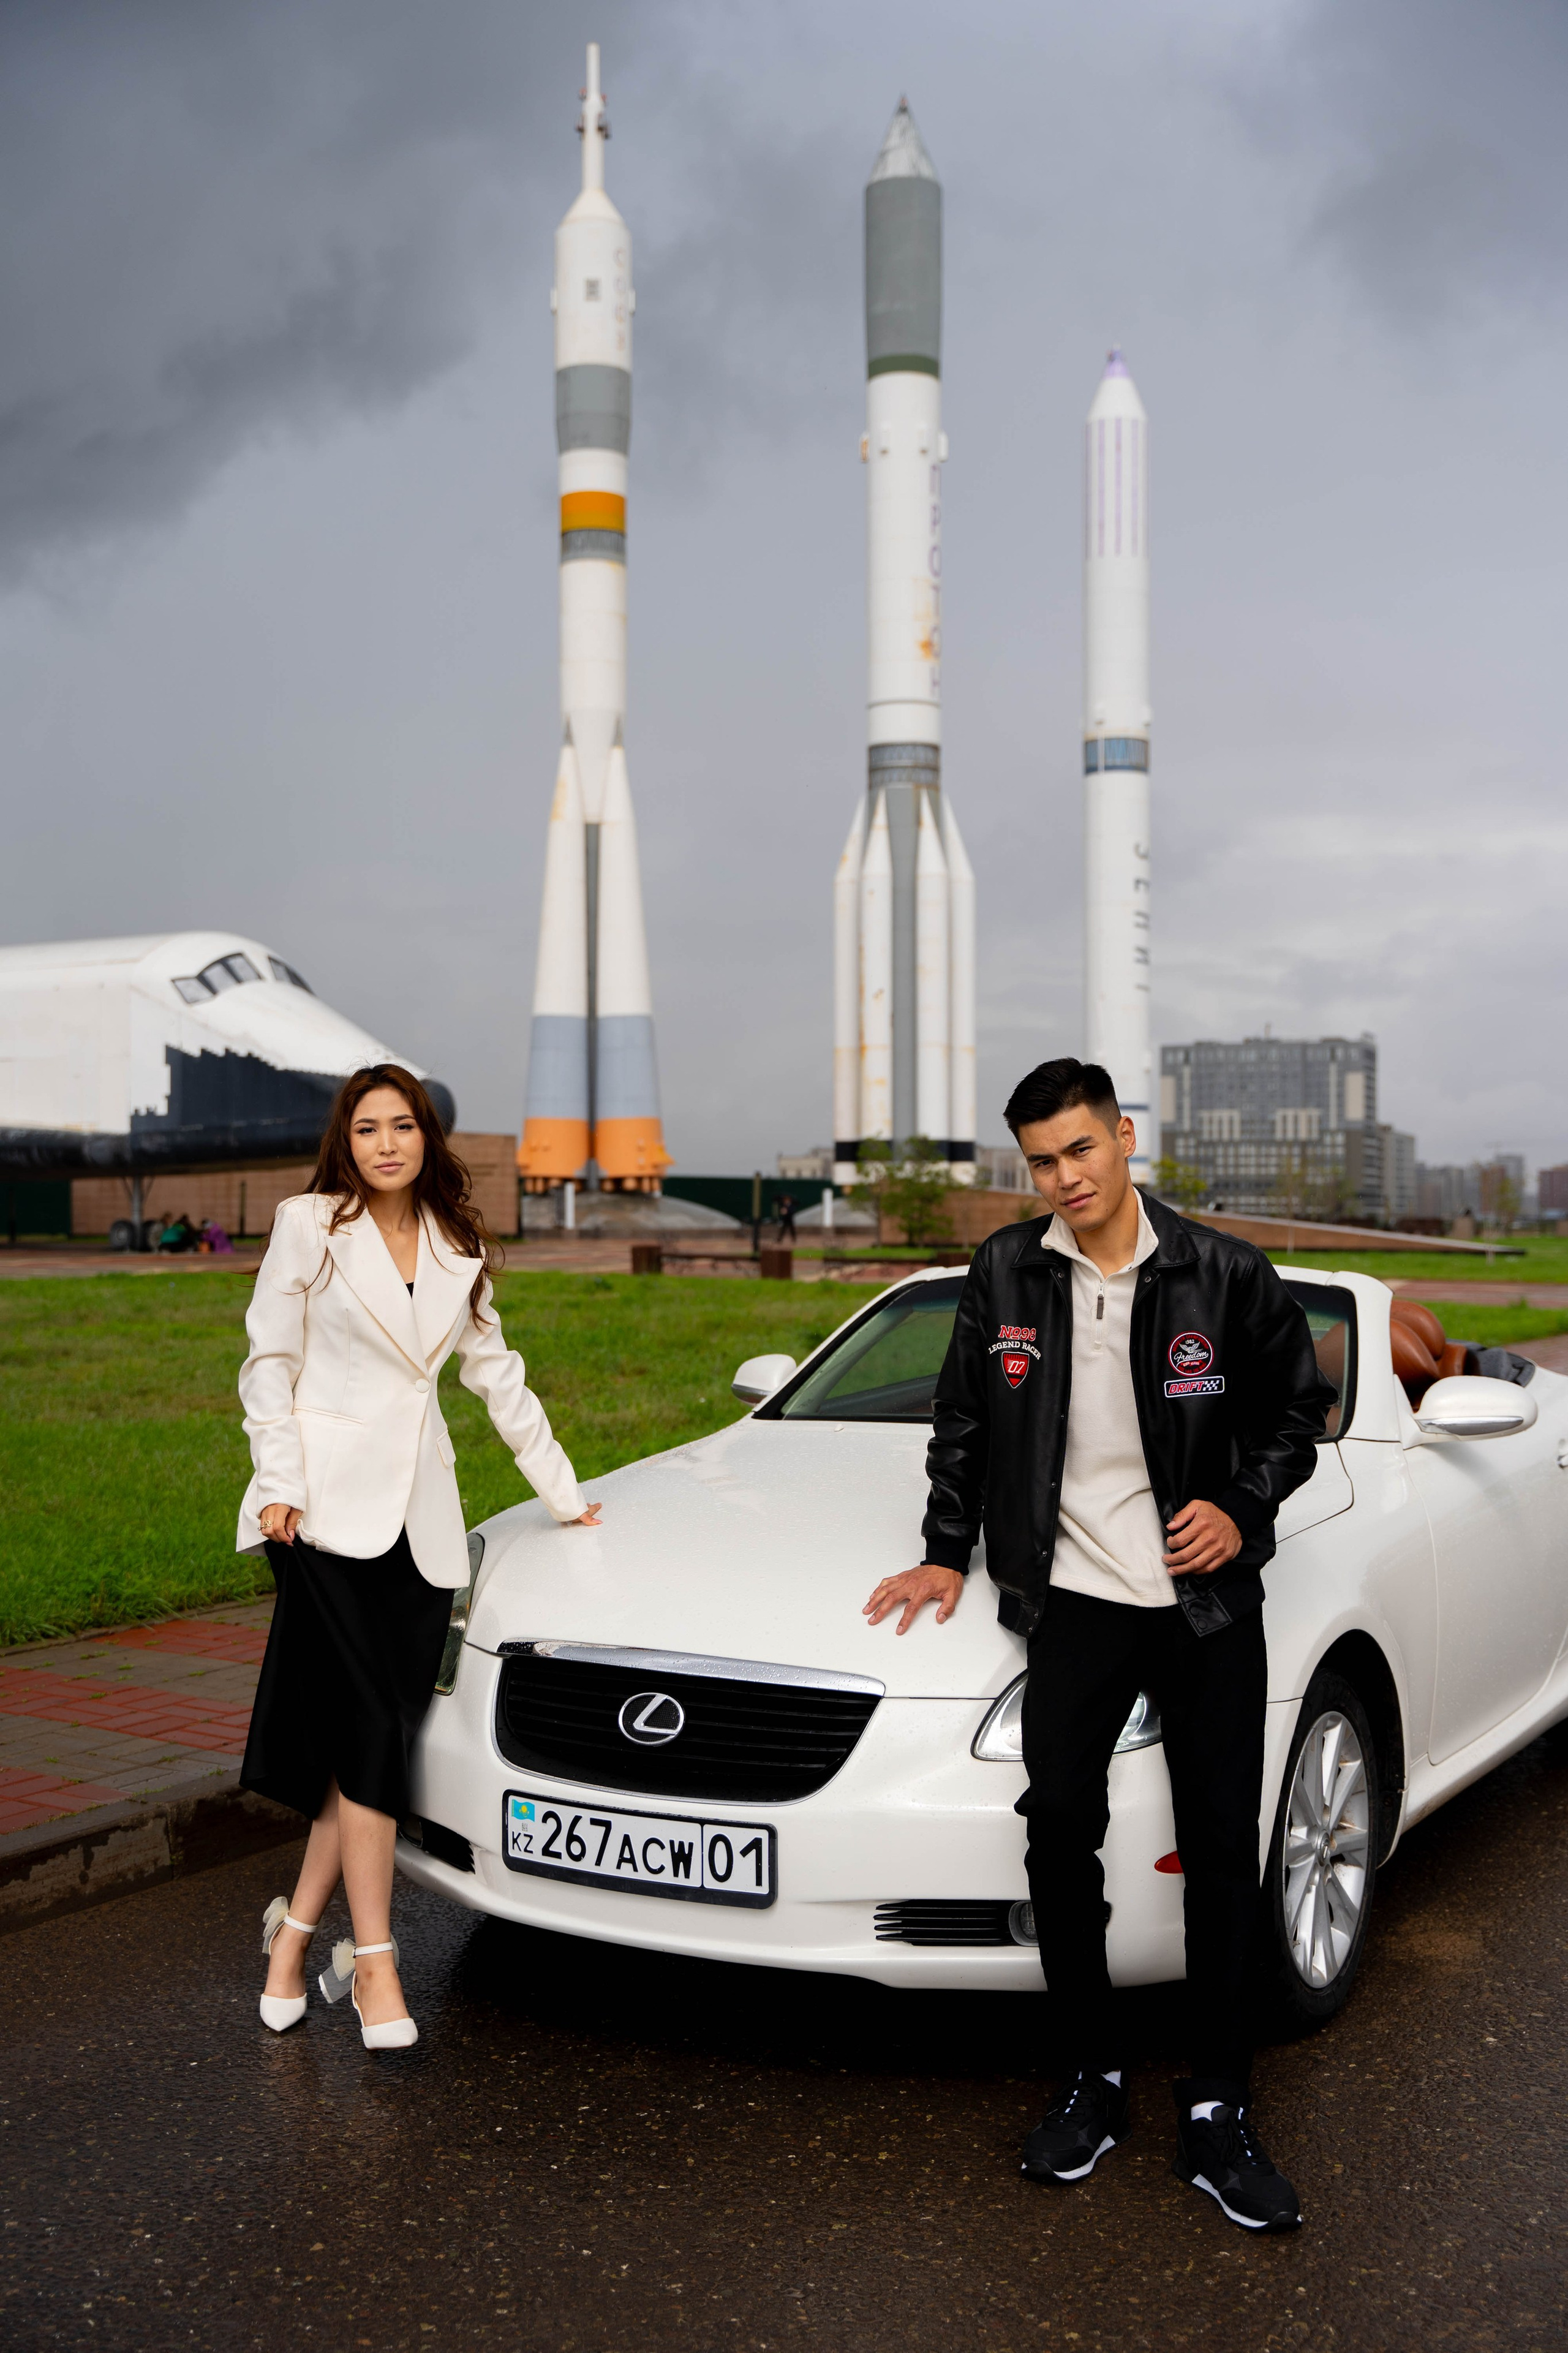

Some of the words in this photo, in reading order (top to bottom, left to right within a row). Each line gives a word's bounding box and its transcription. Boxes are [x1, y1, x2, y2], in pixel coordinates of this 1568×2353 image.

[988, 1341, 1020, 1354] LEGEND
[1022, 1342, 1041, 1360] RACER
[1174, 1351, 1209, 1362] Freedom
[1008, 1361, 1025, 1373] 07
[1169, 1381, 1205, 1394] DRIFT
[512, 1831, 533, 1854] KZ
[708, 1834, 763, 1887] 01
